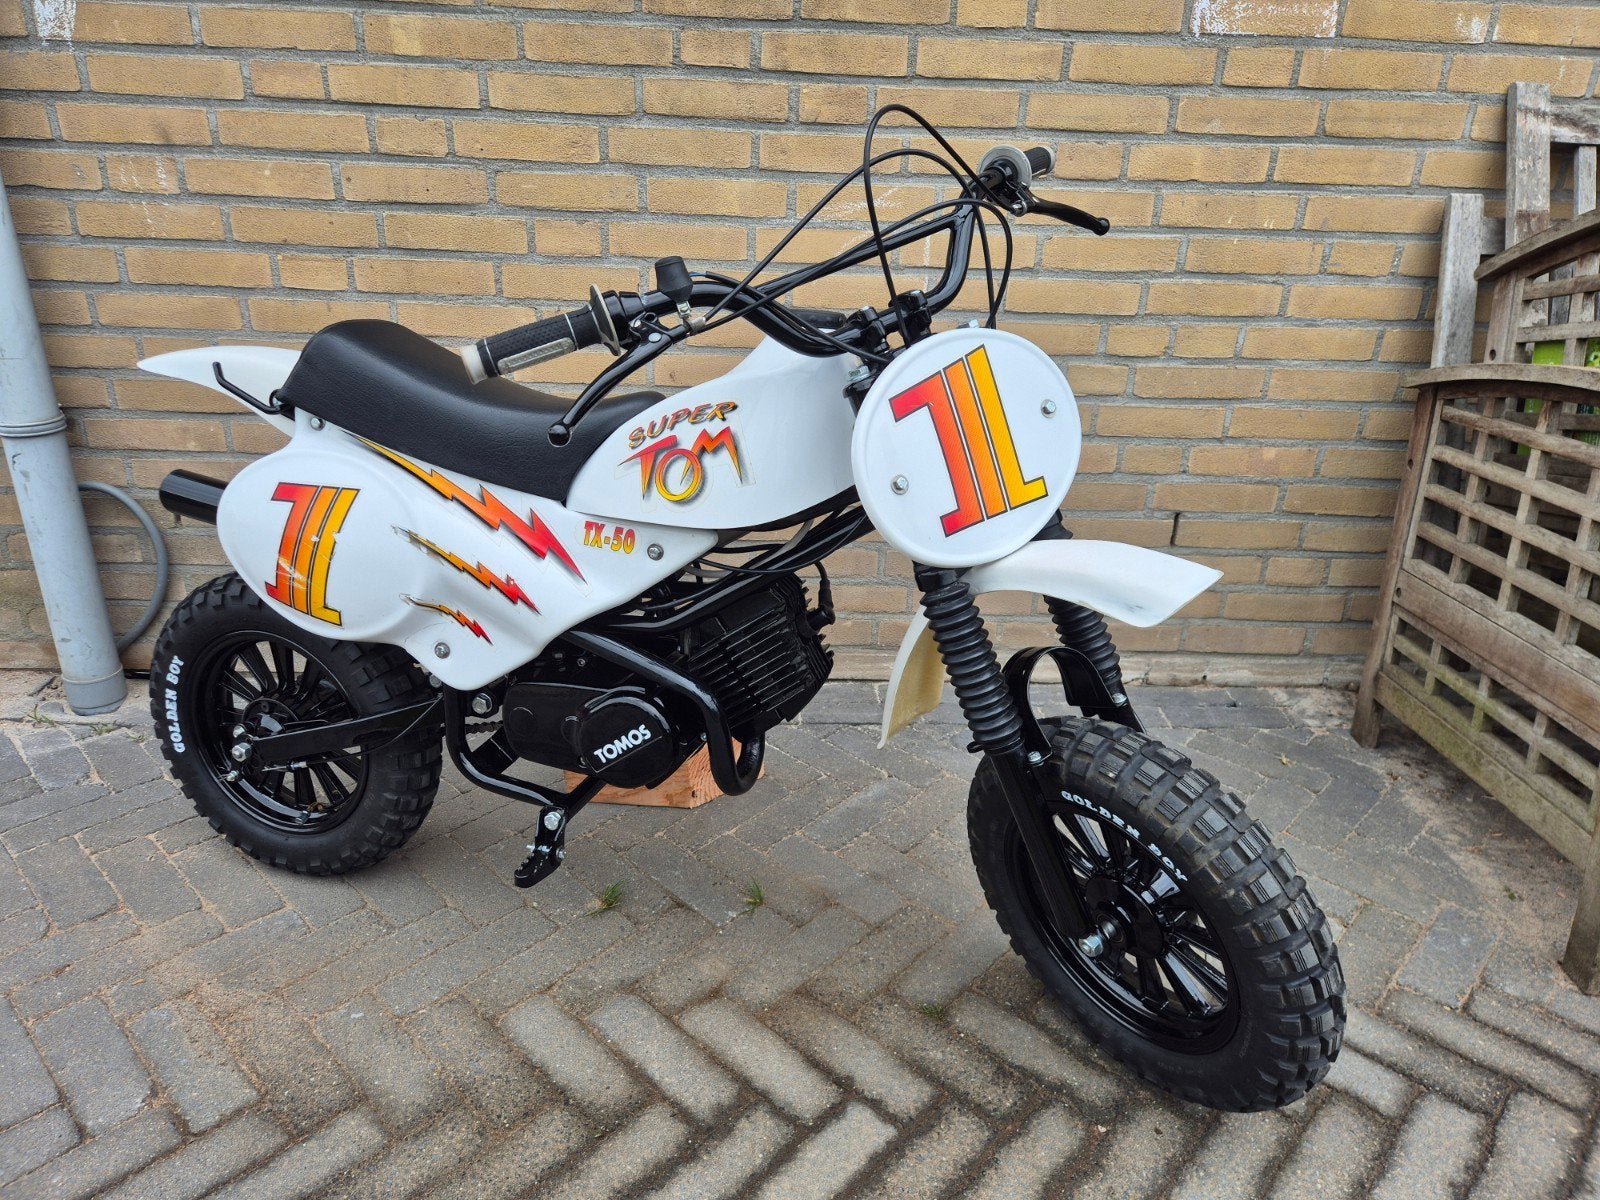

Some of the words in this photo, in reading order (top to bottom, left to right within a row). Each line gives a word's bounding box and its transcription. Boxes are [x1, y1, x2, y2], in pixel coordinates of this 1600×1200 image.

[628, 402, 737, 449] SUPER
[618, 426, 743, 502] TOM
[583, 520, 636, 555] TX-50
[166, 655, 184, 685] BOY
[165, 688, 185, 753] GOLDEN
[593, 724, 652, 764] TOMOS
[1060, 790, 1141, 839] GOLDEN
[1148, 843, 1188, 882] BOY
